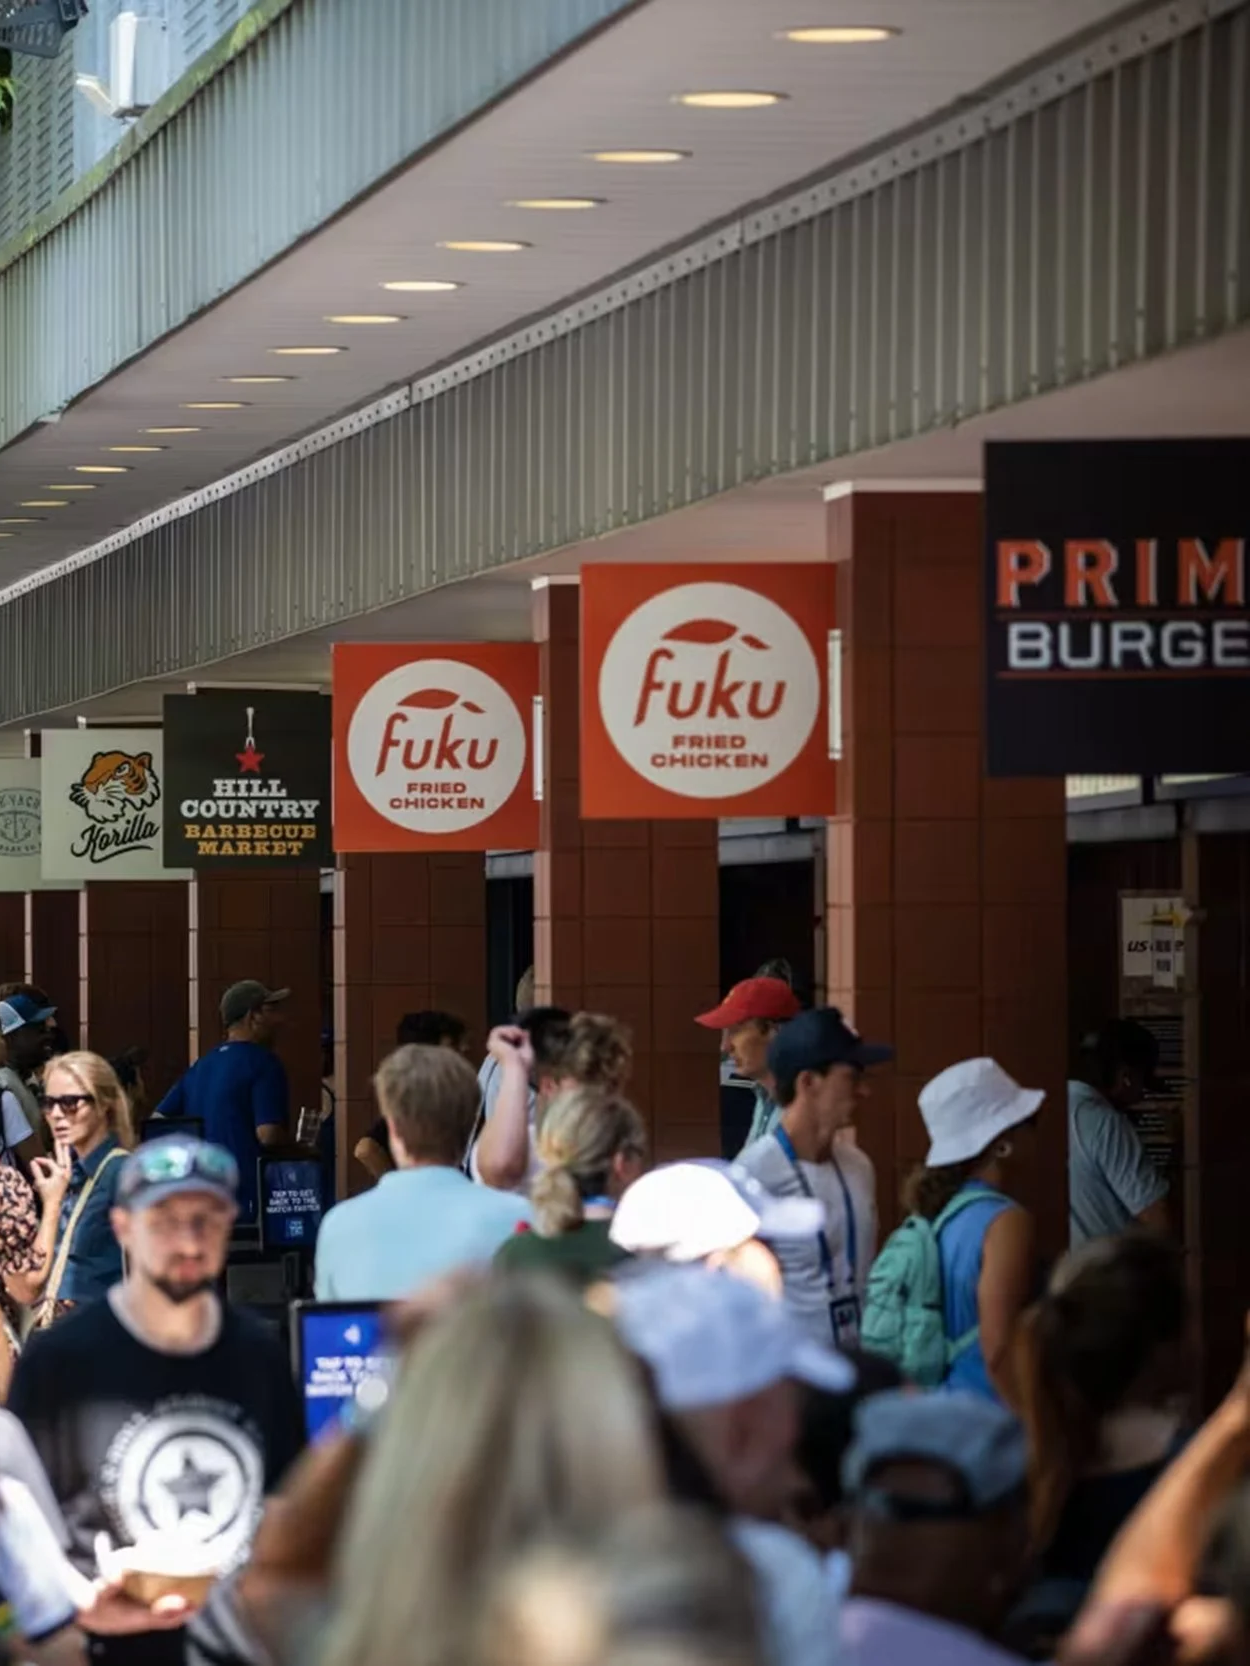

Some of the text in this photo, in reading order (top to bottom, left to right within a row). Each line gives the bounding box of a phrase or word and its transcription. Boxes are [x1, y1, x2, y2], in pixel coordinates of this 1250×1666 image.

[996, 537, 1246, 607] PRIM
[1008, 620, 1250, 669] BURGE
[633, 647, 787, 728] fuku
[376, 711, 499, 777] fuku
[672, 735, 746, 750] FRIED
[650, 752, 769, 769] CHICKEN
[213, 778, 288, 798] HILL
[406, 782, 467, 795] FRIED
[180, 799, 320, 819] COUNTRY
[388, 797, 485, 810] CHICKEN
[70, 813, 161, 864] Korilla
[184, 824, 317, 839] BARBECUE
[198, 840, 304, 857] MARKET
